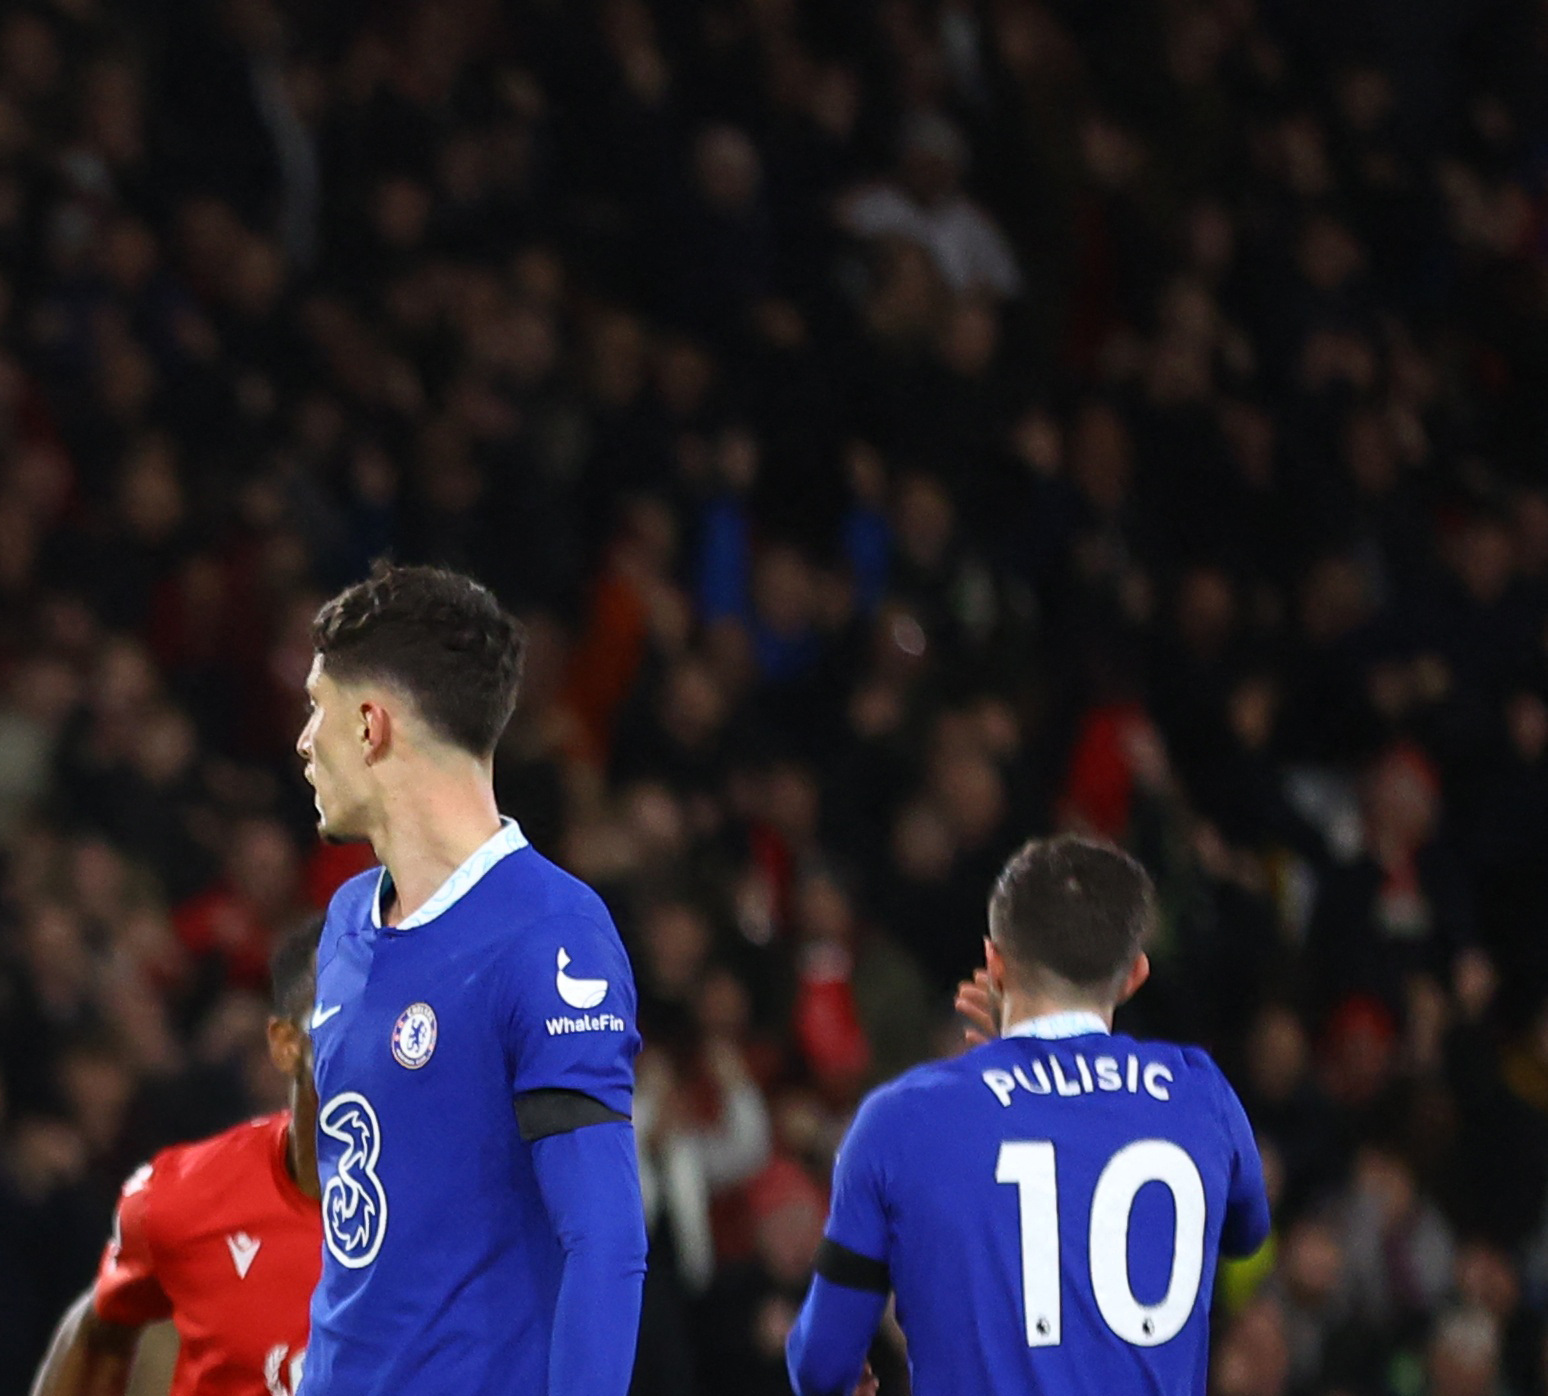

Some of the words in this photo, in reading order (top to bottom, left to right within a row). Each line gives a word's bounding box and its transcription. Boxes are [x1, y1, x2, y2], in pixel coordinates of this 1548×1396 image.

[545, 1013, 624, 1036] WhaleFin
[982, 1054, 1174, 1107] PULISIC
[994, 1138, 1207, 1347] 10
